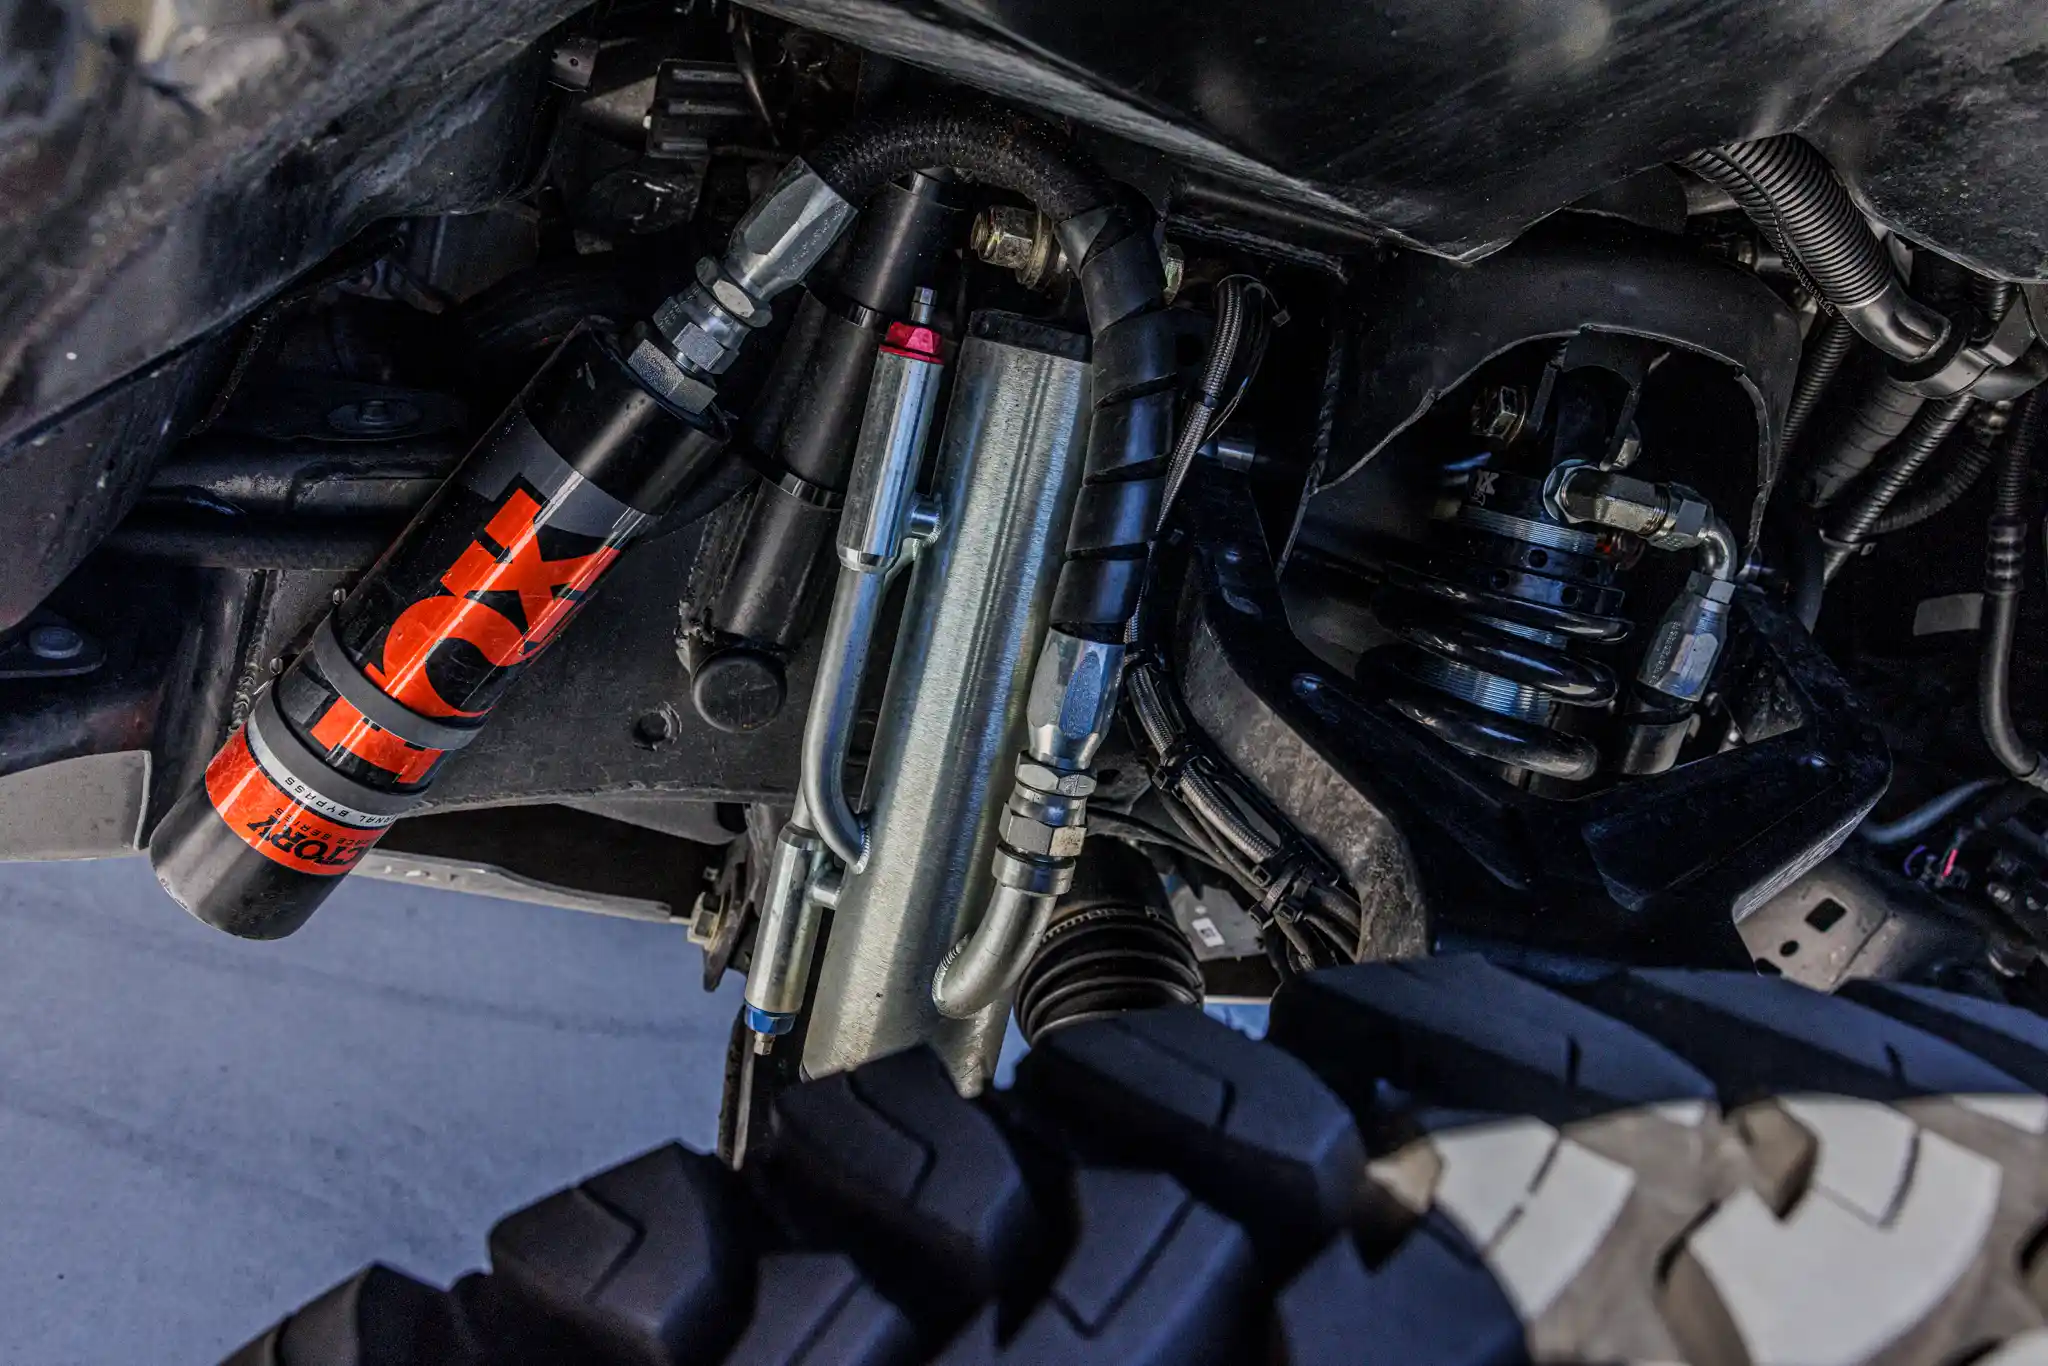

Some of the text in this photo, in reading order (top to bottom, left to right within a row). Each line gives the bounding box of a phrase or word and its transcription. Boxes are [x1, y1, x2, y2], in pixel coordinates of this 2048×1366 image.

[274, 807, 332, 841] SERIES
[285, 777, 398, 825] RNAL BYPASS
[247, 814, 366, 866] CTORY
